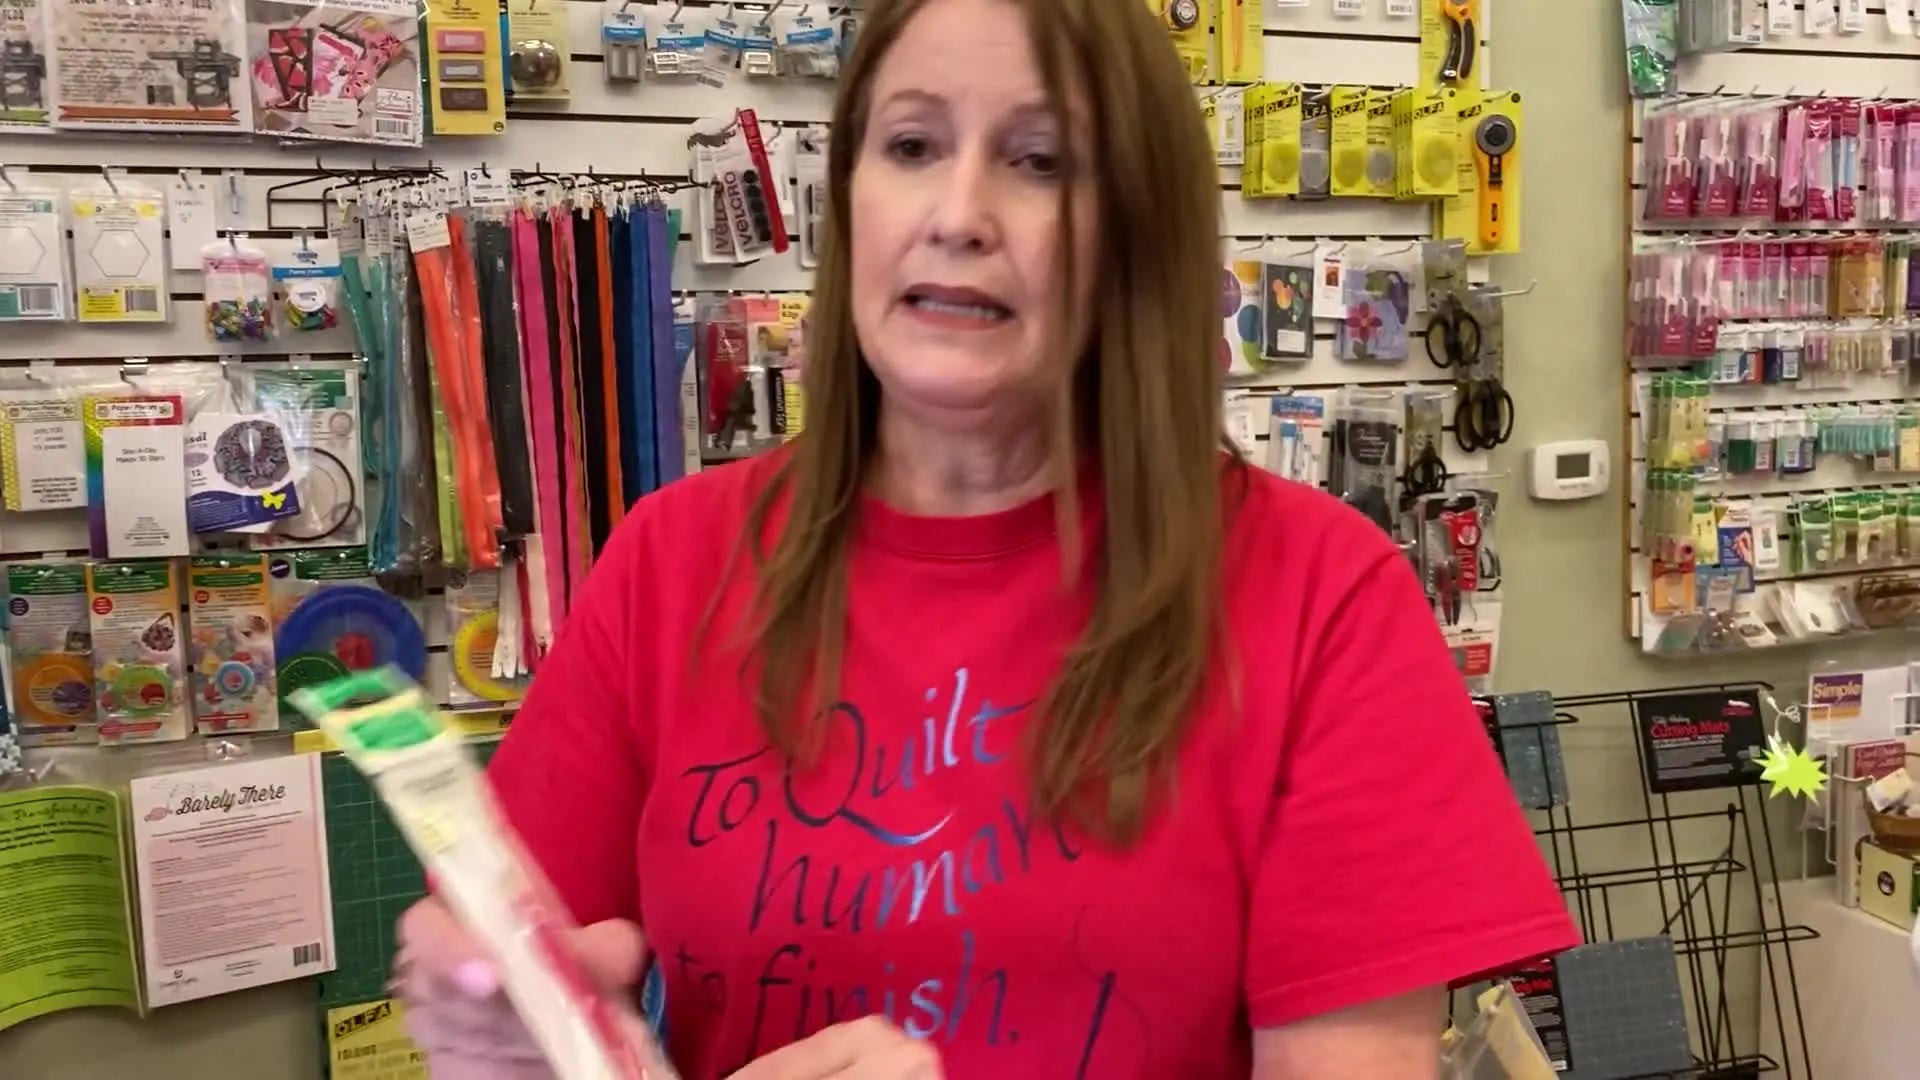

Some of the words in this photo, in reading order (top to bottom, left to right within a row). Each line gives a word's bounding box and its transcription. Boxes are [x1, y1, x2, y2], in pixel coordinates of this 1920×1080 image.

[1265, 96, 1299, 114] OLFA
[1303, 104, 1328, 120] LFA
[1333, 99, 1366, 118] OLFA
[1413, 101, 1445, 120] OLFA
[1457, 104, 1483, 121] LFA
[1813, 681, 1861, 702] Simple
[680, 746, 773, 848] To
[785, 668, 1038, 845] Quilt
[176, 788, 237, 814] Barely
[238, 784, 286, 805] There
[335, 1001, 392, 1038] OLFA
